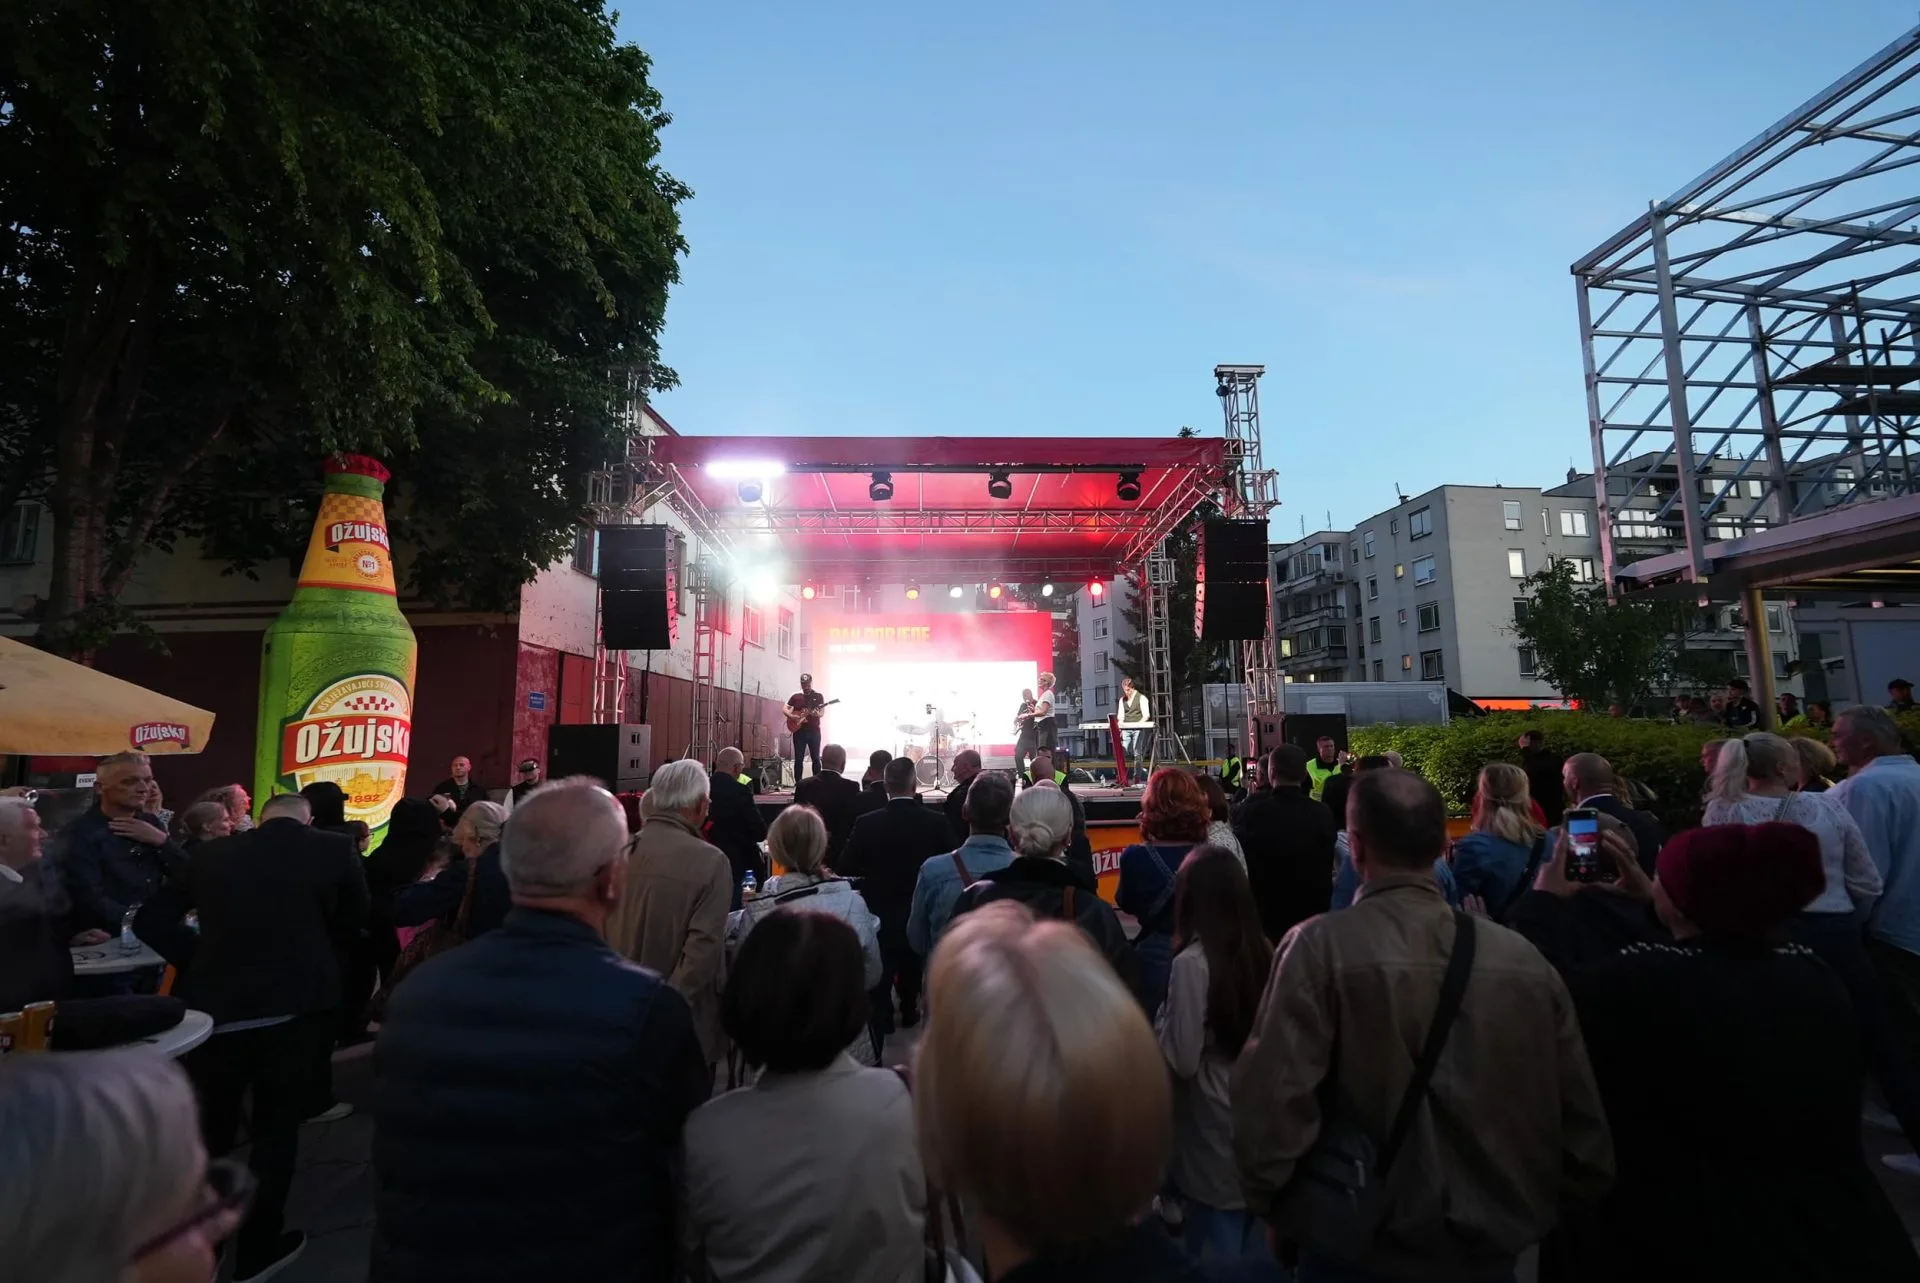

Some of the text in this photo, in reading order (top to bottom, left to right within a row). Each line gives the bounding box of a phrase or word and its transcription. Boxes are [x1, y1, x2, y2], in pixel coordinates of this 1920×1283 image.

[135, 724, 186, 743] Ožujsko
[349, 794, 381, 803] 1892
[1092, 848, 1126, 875] Ožu
